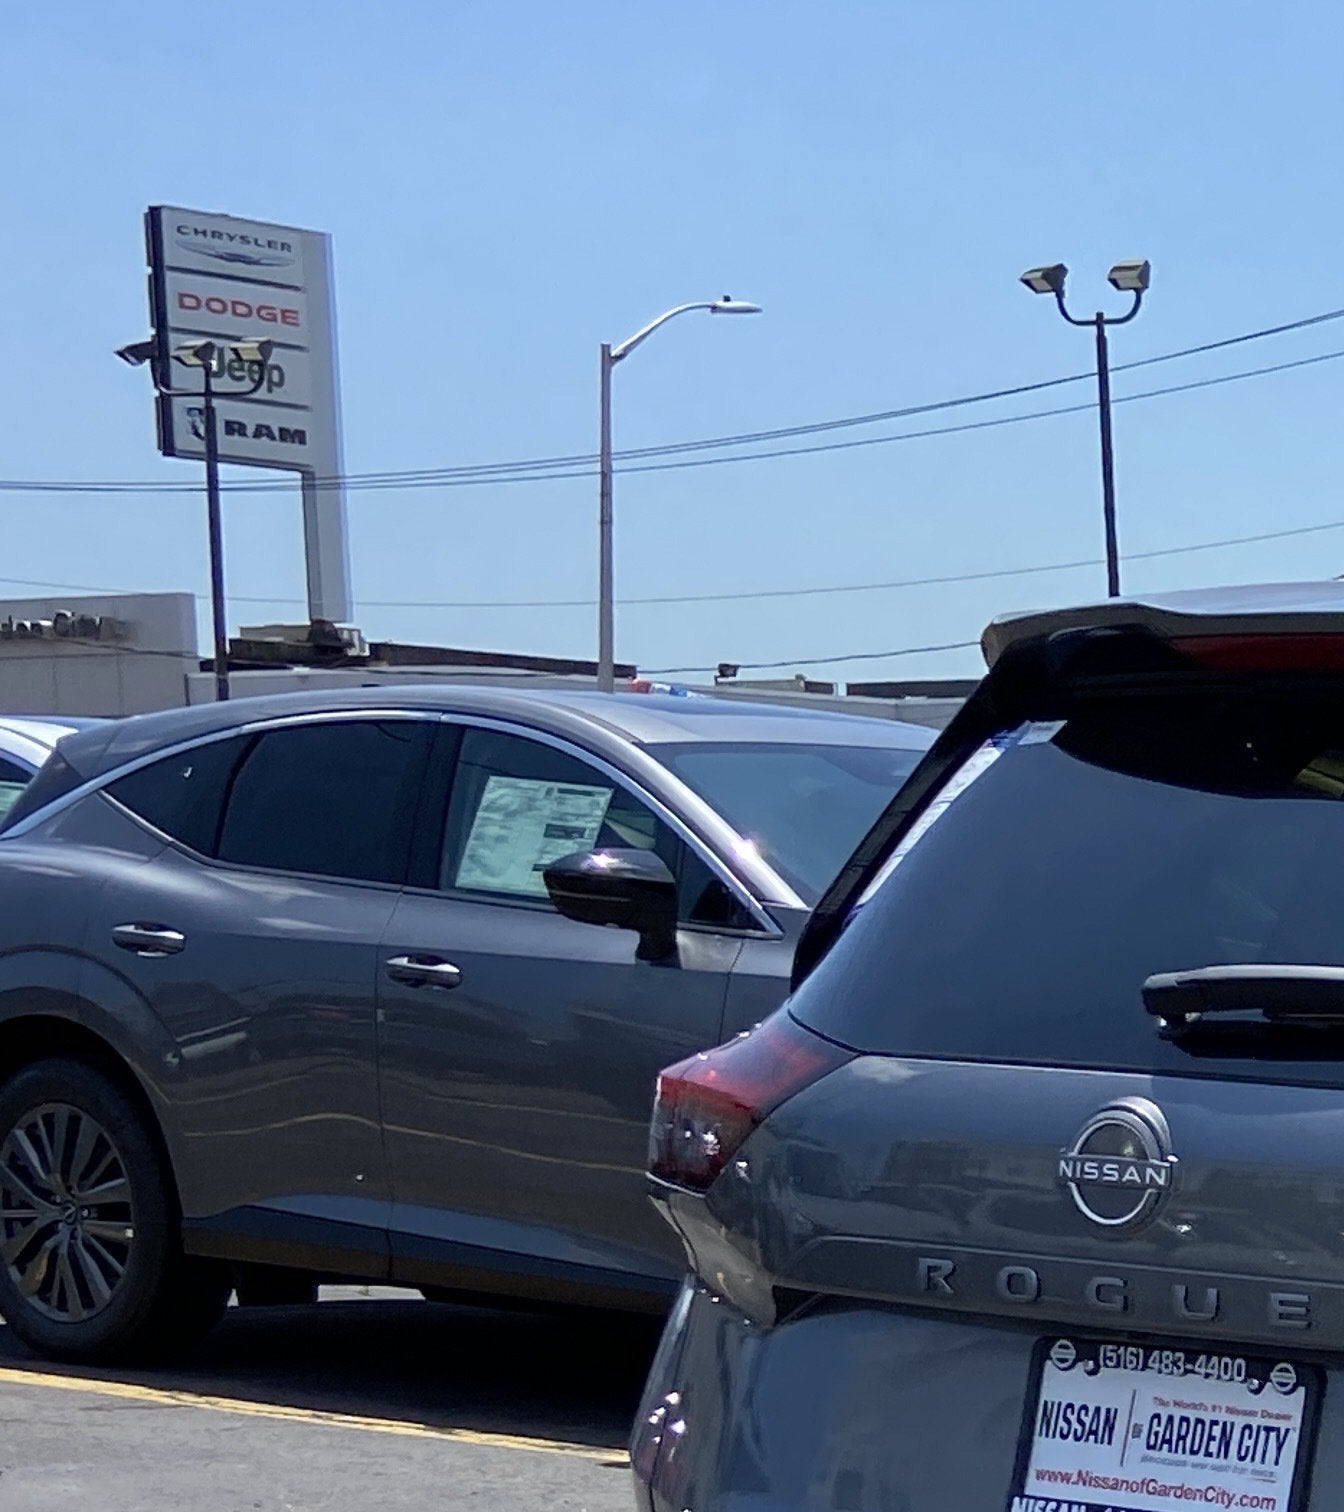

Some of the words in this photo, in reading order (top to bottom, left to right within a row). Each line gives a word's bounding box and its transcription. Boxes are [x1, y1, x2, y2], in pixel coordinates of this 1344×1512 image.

[176, 224, 292, 253] CHRYSLER
[177, 292, 300, 327] DODGE
[224, 419, 307, 446] RAM
[1059, 1160, 1166, 1186] NISSAN
[918, 1257, 1312, 1330] ROGUE
[1099, 1344, 1144, 1369] (516)
[1148, 1349, 1247, 1383] 483-4400
[1038, 1399, 1118, 1447] NISSAN
[1145, 1412, 1235, 1461] GARDEN
[1236, 1423, 1291, 1467] CITY
[1034, 1467, 1277, 1512] www.NissanofGardenCity.com
